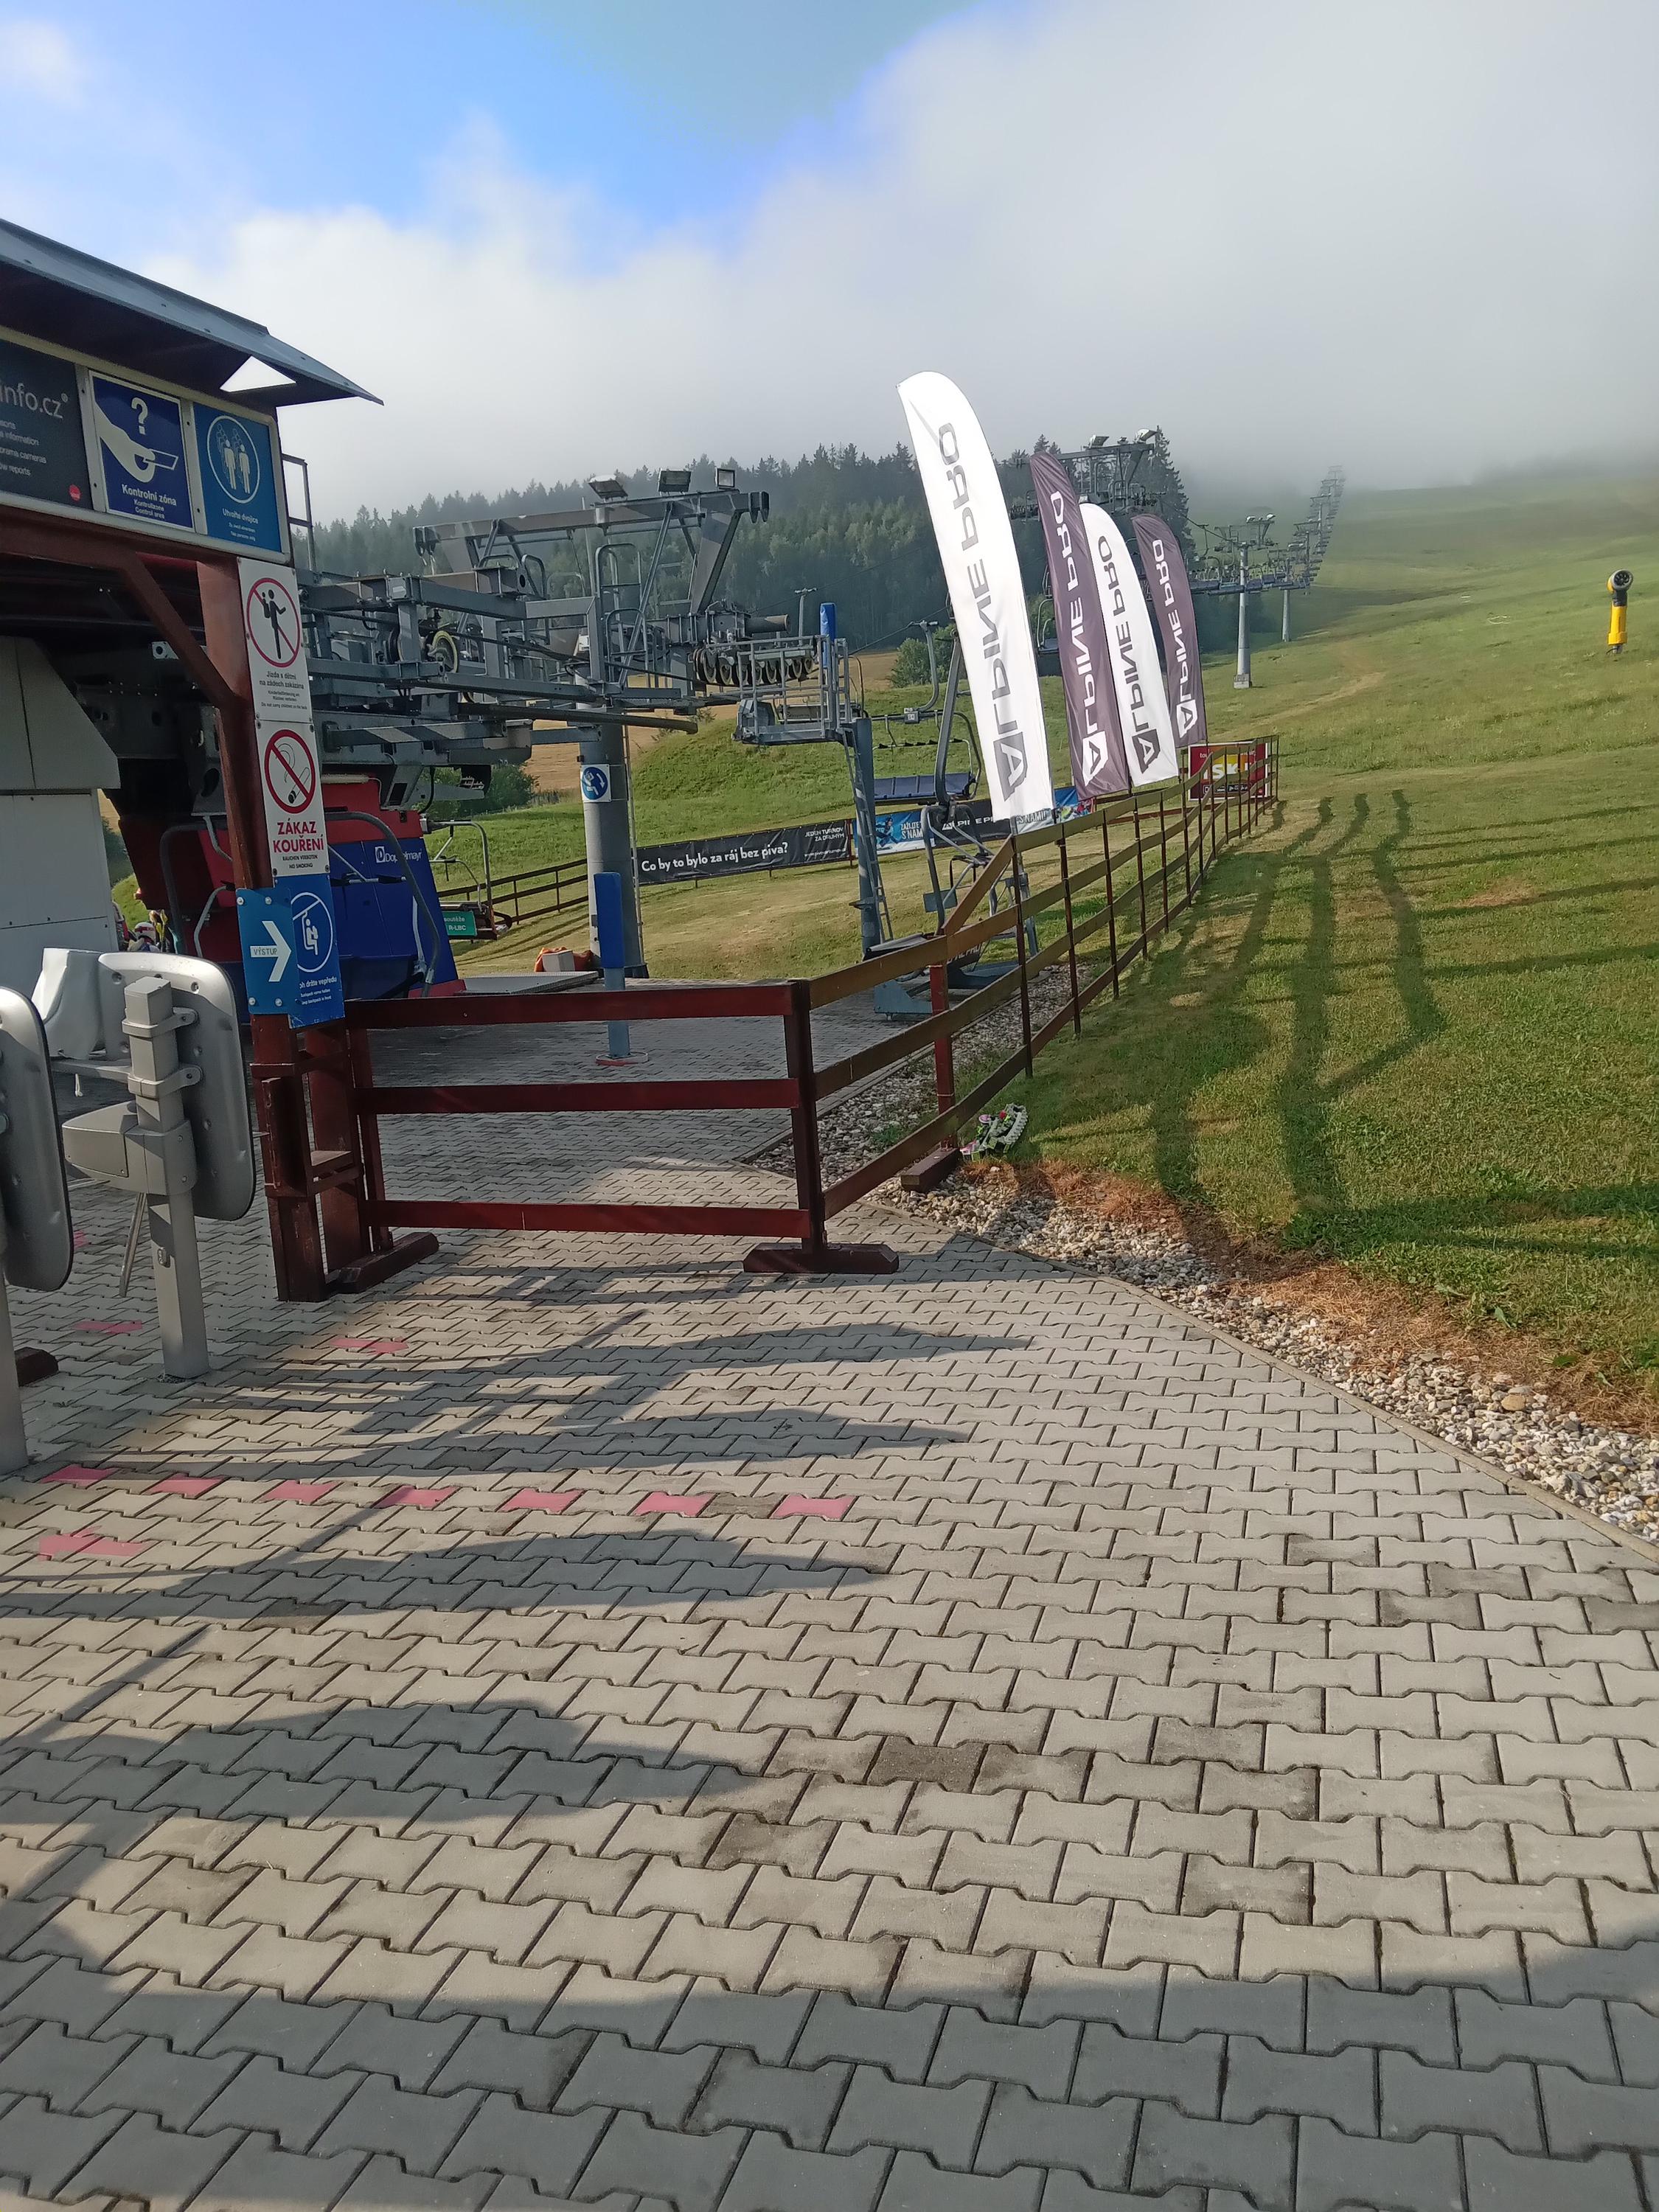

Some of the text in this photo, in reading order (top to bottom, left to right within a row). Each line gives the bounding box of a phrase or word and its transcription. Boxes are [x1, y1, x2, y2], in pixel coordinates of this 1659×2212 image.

[159, 494, 176, 506] zóna
[277, 817, 317, 835] ZÁKAZ
[273, 834, 324, 852] KOUŘENÍ
[641, 842, 788, 872] Co by to bylo za ráj bez piva?
[254, 947, 278, 956] VÝSTUP
